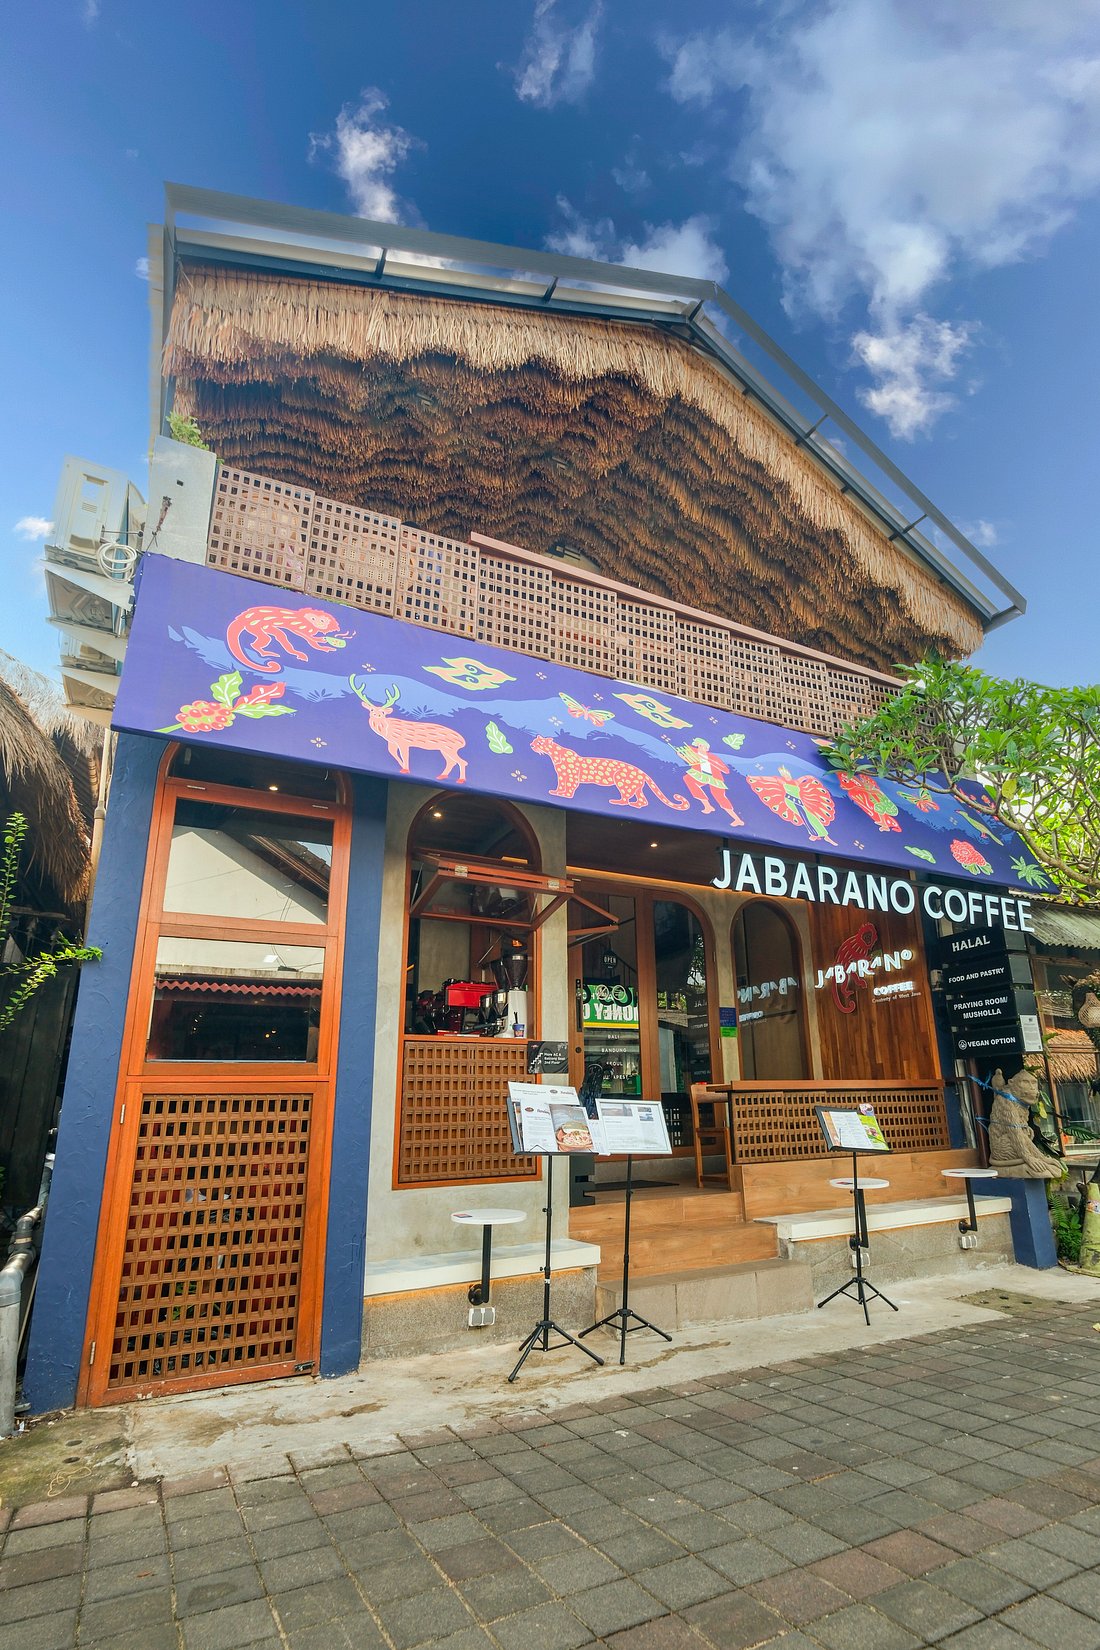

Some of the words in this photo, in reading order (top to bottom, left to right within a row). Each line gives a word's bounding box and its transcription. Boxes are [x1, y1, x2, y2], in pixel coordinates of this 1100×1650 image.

[712, 849, 915, 915] JABARANO
[923, 886, 1035, 933] COFFEE
[952, 935, 991, 952] HALAL
[814, 949, 913, 989] JABARANO
[948, 973, 965, 984] FOOD
[966, 972, 979, 981] AND
[980, 967, 1005, 978] PASTRY
[873, 981, 914, 996] COFFEE
[953, 1000, 984, 1011] PRAYING
[963, 1008, 1002, 1019] MUSHOLLA
[967, 1039, 990, 1048] VEGAN
[990, 1036, 1016, 1046] OPTION
